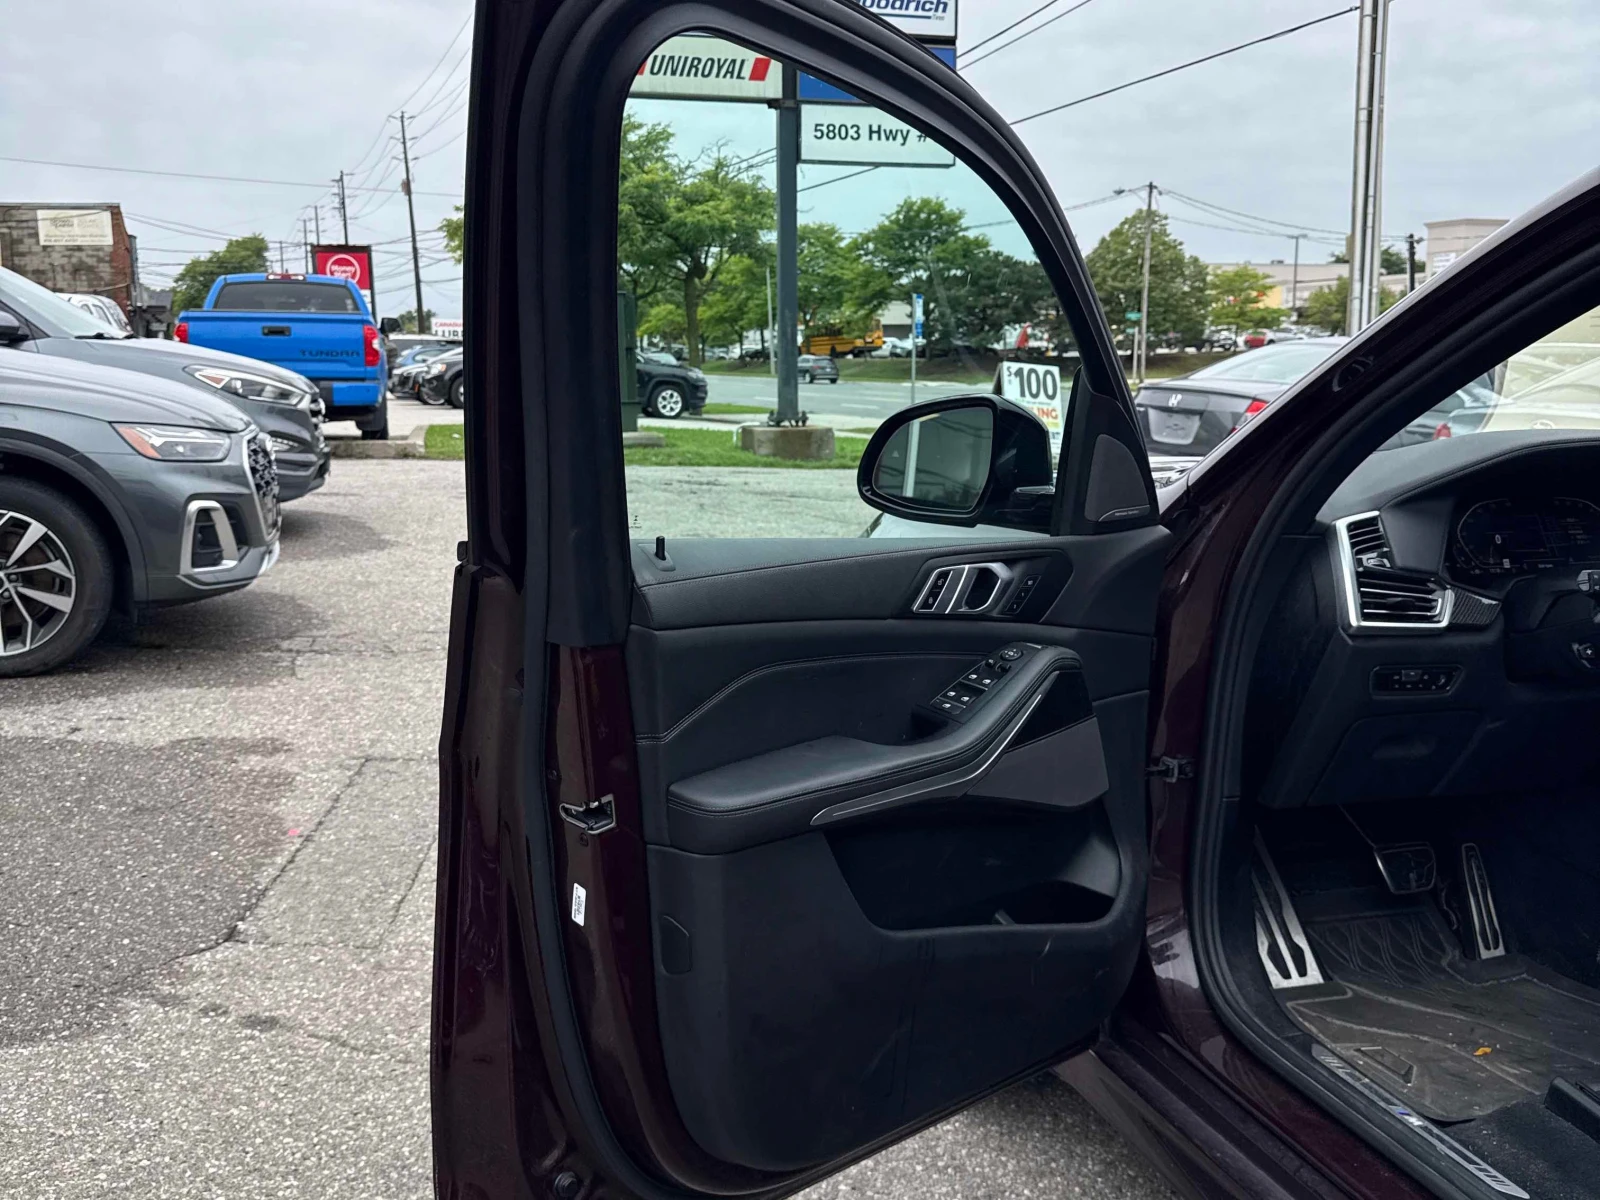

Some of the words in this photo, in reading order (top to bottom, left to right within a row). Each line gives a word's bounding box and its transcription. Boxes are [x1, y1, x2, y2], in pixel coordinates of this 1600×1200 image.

[649, 54, 748, 81] UNIROYAL
[813, 123, 861, 141] 5803
[868, 124, 910, 146] Hwy
[299, 349, 361, 358] TUNDRA
